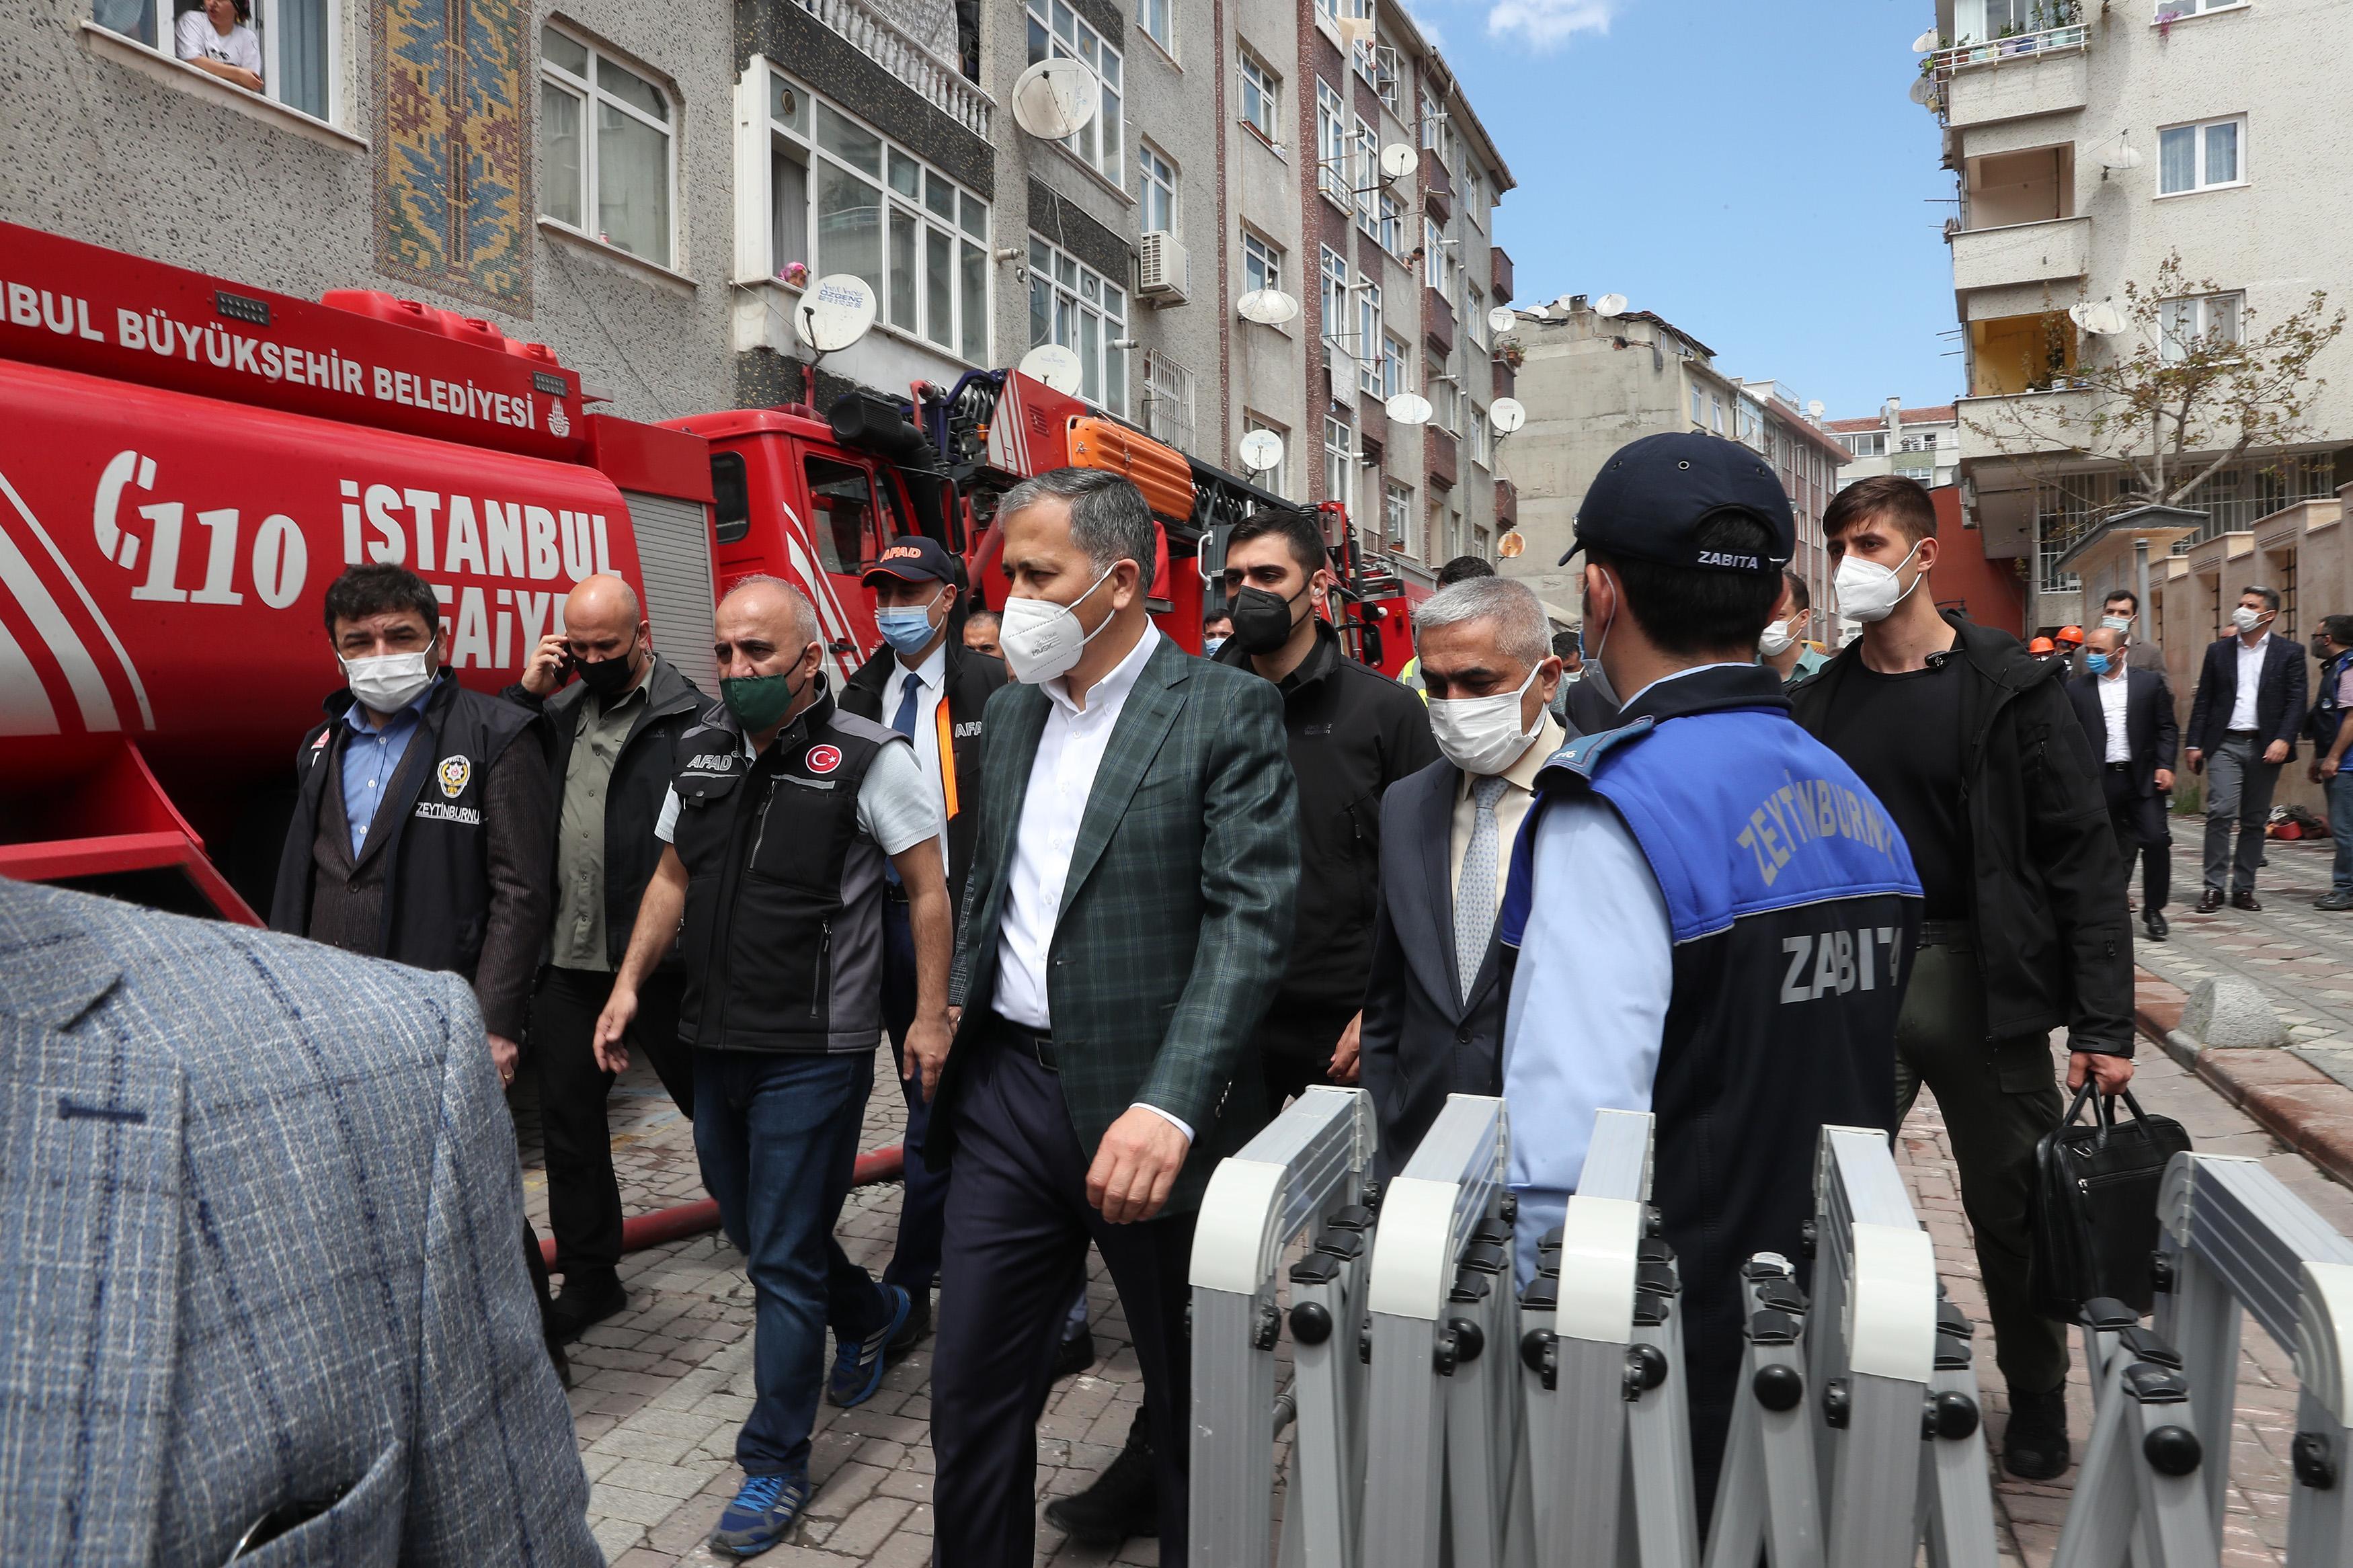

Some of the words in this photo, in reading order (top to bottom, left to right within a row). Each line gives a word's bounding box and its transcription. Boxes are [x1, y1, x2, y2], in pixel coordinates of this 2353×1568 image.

[0, 280, 105, 343] BUL
[117, 306, 364, 396] BÜYÜKŞEHİR
[373, 365, 535, 430] BELEDİYESİ
[879, 546, 922, 563] AFAD
[1697, 550, 1759, 569] ZABITA
[955, 721, 982, 738] AFA
[686, 754, 733, 772] AFAD
[416, 801, 480, 823] ZEYTİNBURNU
